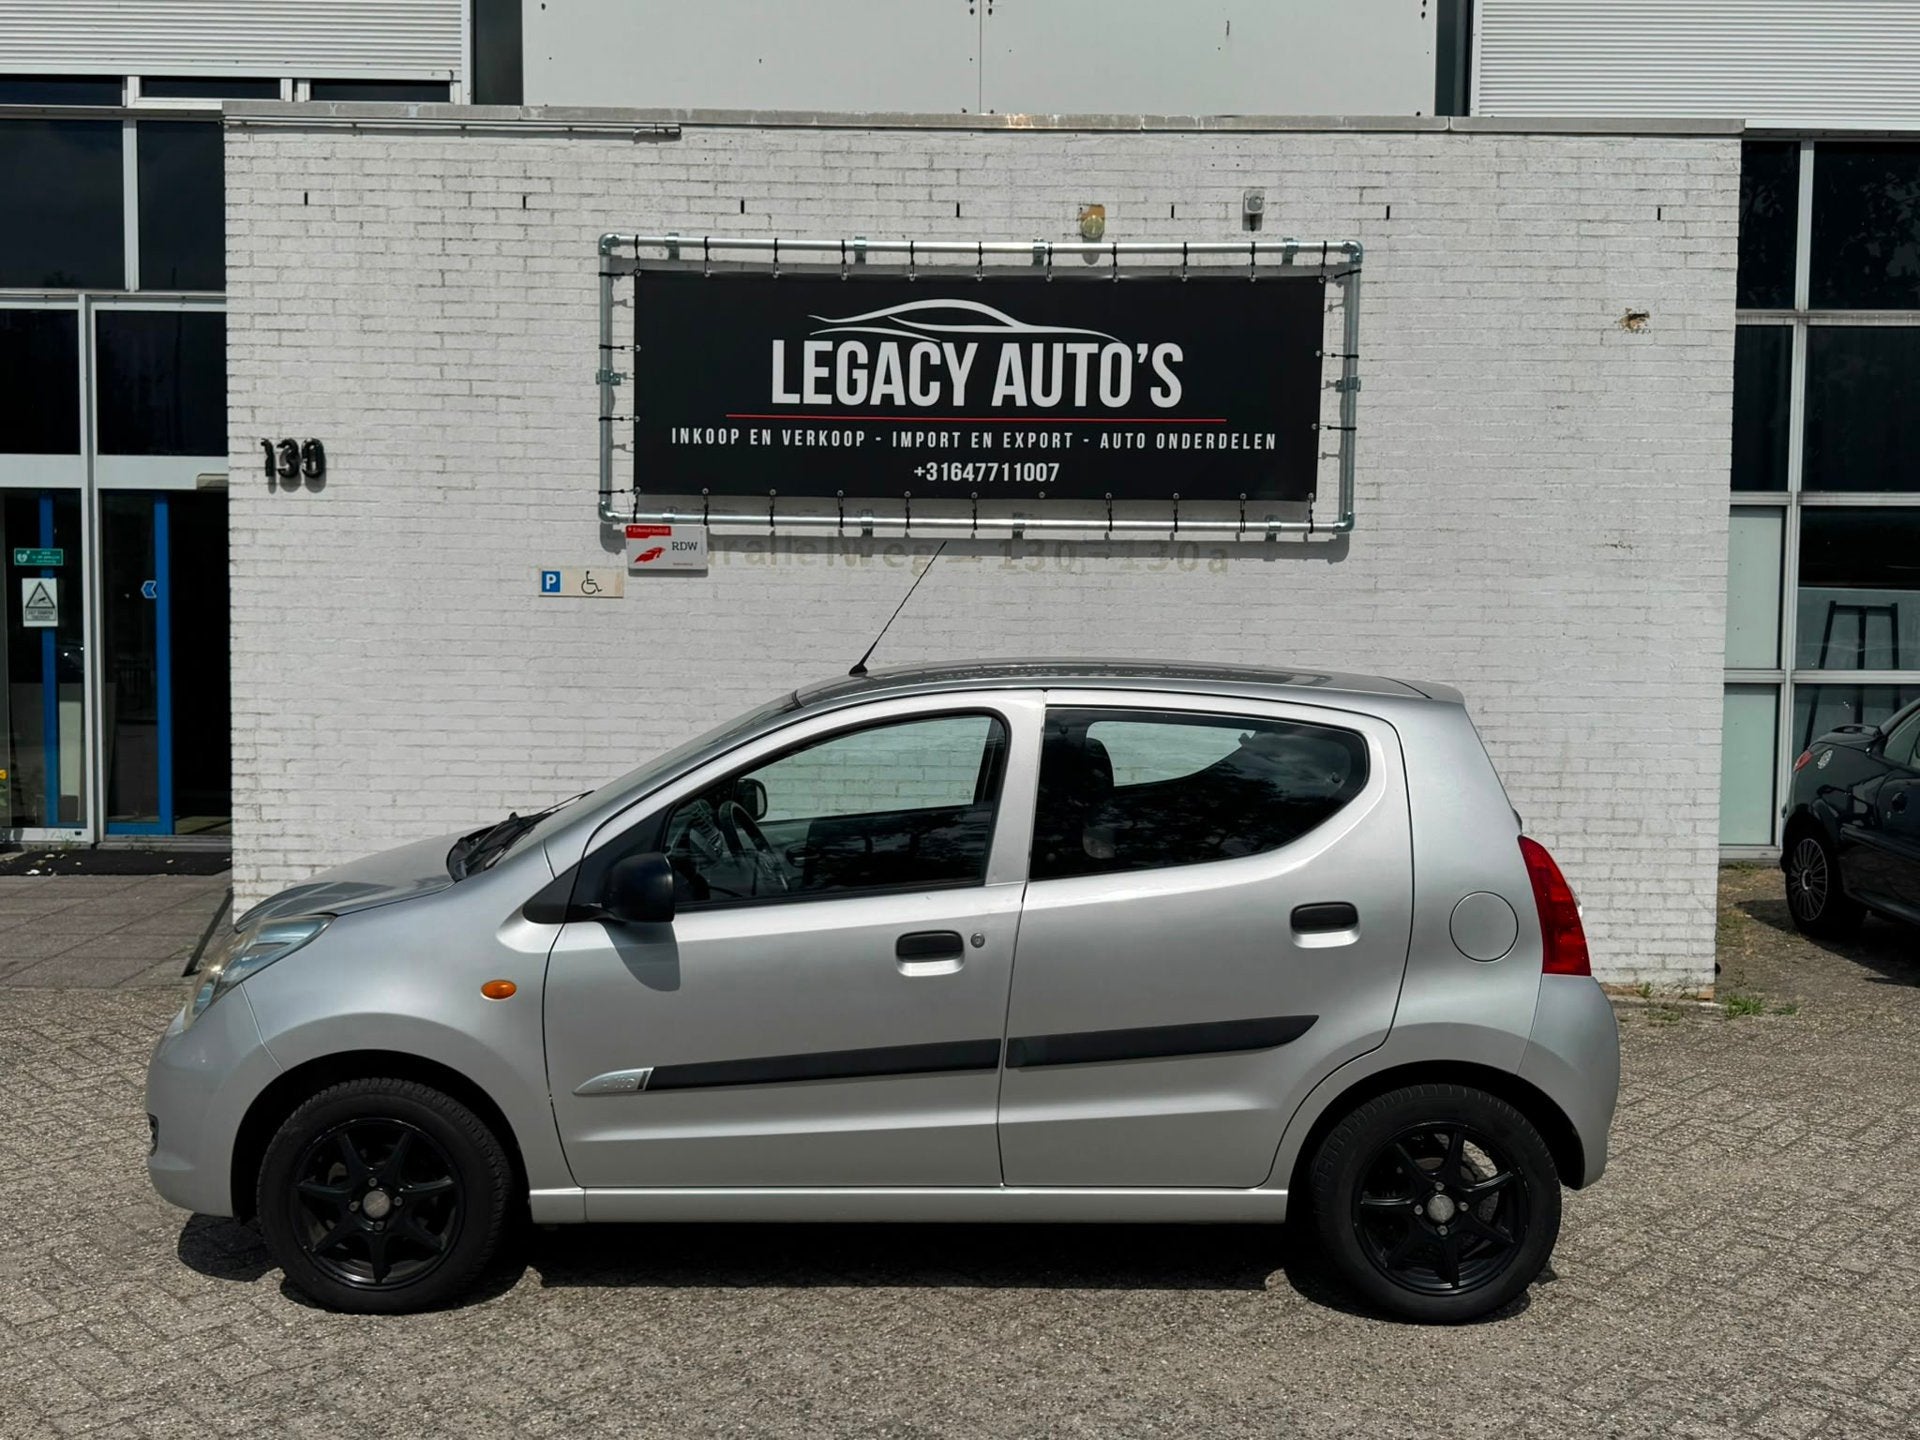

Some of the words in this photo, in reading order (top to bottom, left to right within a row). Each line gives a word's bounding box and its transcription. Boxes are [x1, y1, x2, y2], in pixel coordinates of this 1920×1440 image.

[771, 339, 979, 407] LEGACY
[991, 341, 1184, 408] AUTO'S
[672, 427, 740, 445] INKOOP
[750, 429, 771, 446] EN
[782, 429, 865, 447] VERKOOP
[892, 431, 962, 448] IMPORT
[971, 432, 992, 449] EN
[1003, 432, 1073, 449] EXPORT
[1100, 432, 1146, 449] AUTO
[1156, 432, 1276, 450] ONDERDELEN
[913, 461, 1060, 482] +31647711007
[672, 541, 698, 551] RDW
[545, 573, 557, 589] P
